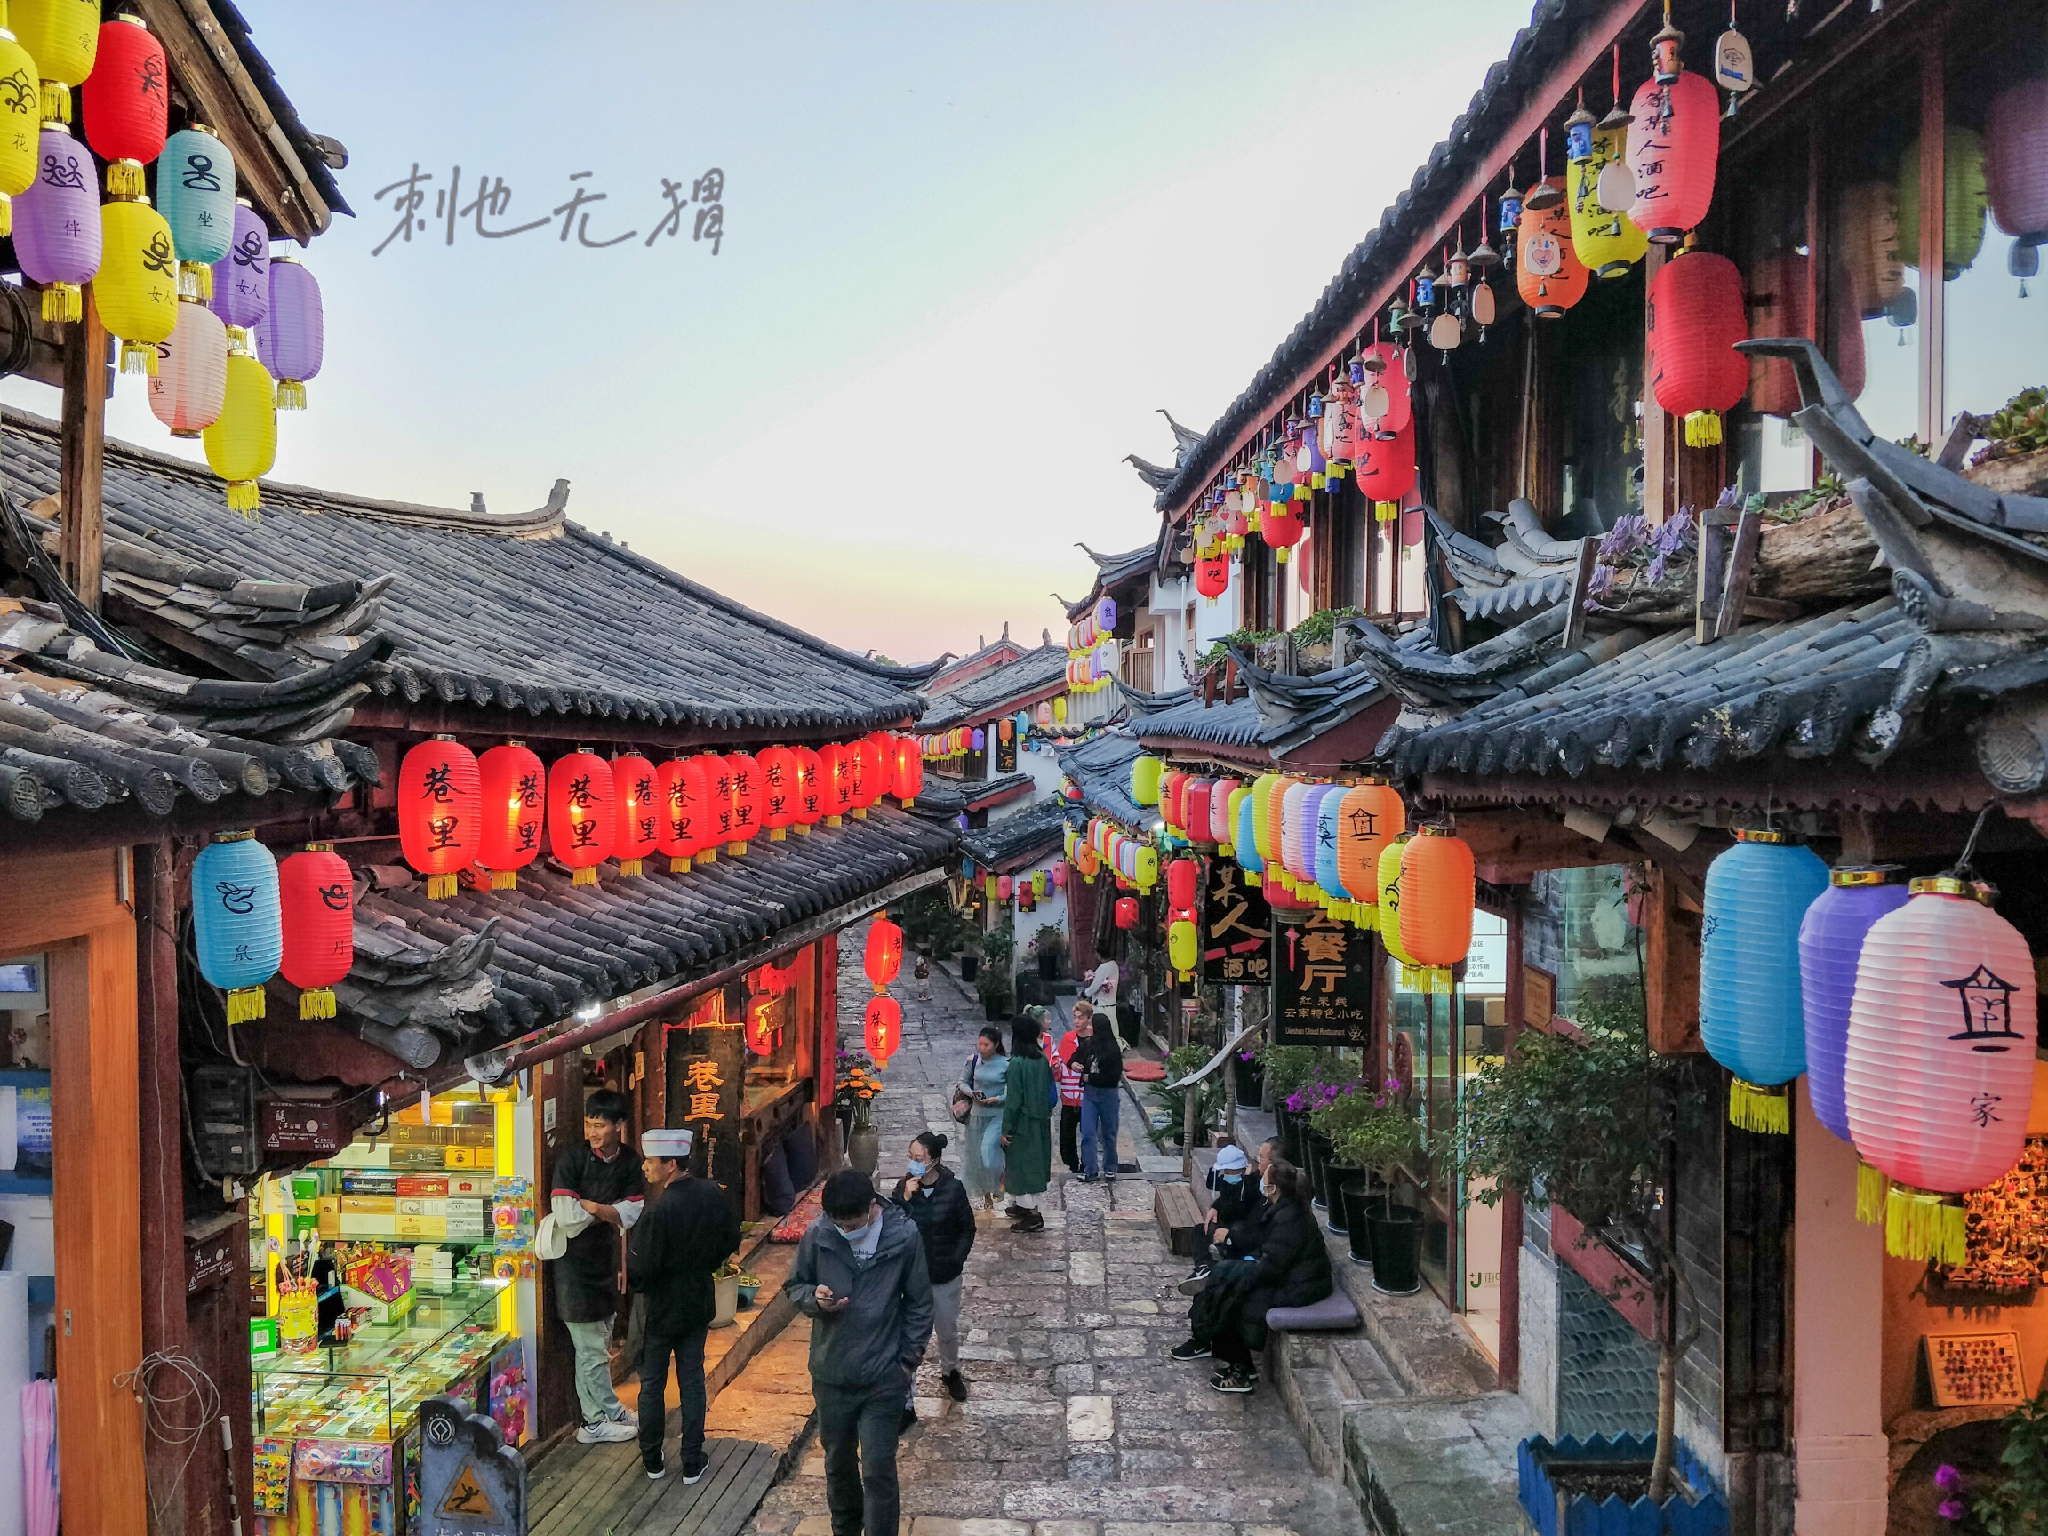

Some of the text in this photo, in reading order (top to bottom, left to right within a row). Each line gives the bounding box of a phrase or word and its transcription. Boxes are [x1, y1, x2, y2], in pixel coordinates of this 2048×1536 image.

[13, 132, 29, 153] 花
[64, 219, 81, 238] 伴
[148, 285, 173, 306] 女人
[236, 279, 261, 299] 女人
[421, 763, 466, 852] 巷里
[515, 770, 542, 852] 巷里
[567, 773, 603, 850] 巷里
[634, 774, 658, 843] 巷里
[667, 778, 697, 843] 巷里
[731, 770, 756, 829] 巷里
[764, 762, 788, 817] 巷里
[802, 763, 821, 813] 巷里
[1223, 957, 1269, 979] 酒吧
[870, 1010, 887, 1051] 巷里
[1284, 1008, 1364, 1020] 云南特色小吃
[683, 1060, 725, 1122] 巷里
[1970, 1092, 2004, 1128] 家
